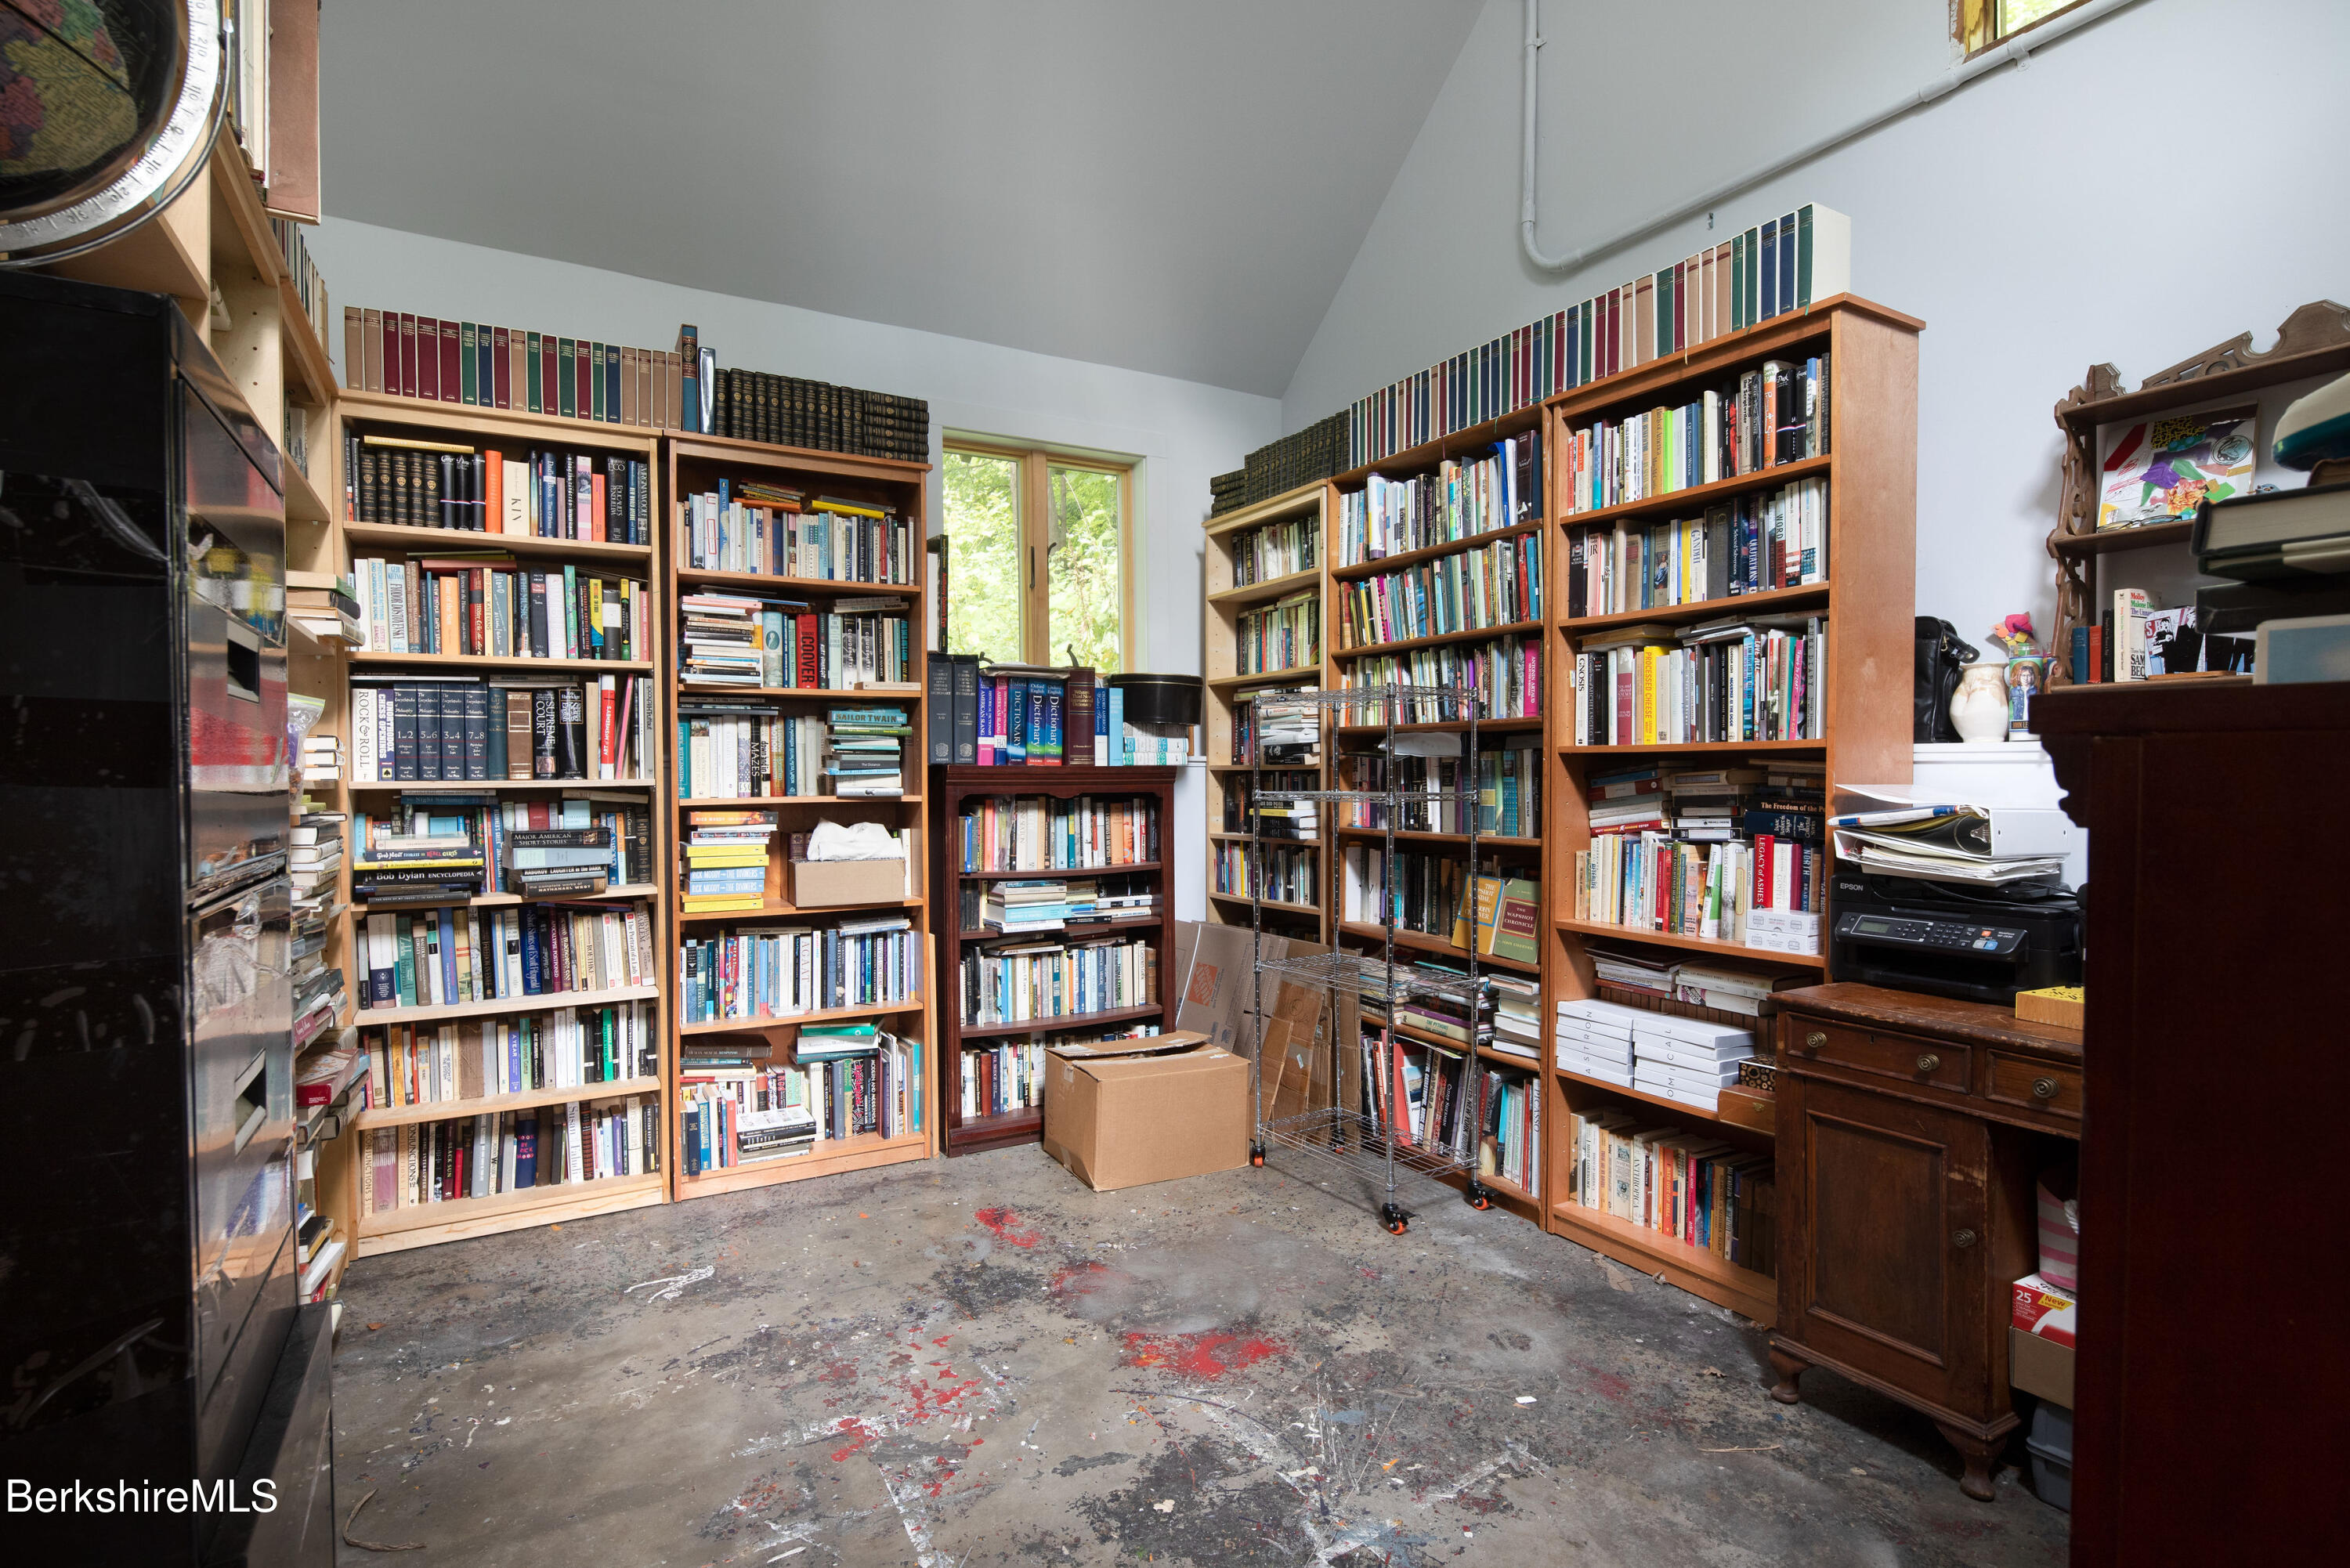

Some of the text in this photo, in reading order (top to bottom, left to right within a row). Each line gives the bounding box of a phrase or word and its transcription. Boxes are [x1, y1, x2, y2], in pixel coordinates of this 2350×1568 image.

[1775, 514, 1784, 540] WORD
[1690, 529, 1701, 565] GANDHI
[1748, 539, 1759, 582] QUOTATIONS
[390, 583, 405, 639] FYODOR DOSTOYEVSKY
[2131, 592, 2146, 602] Molloy
[801, 637, 815, 683] COOVER
[1578, 658, 1586, 692] GNOSIS
[359, 692, 369, 724] ROCK
[537, 701, 545, 735] COURT
[546, 701, 555, 744] SUPREME
[1013, 690, 1022, 747] DICTIONARY
[1030, 695, 1043, 747] Dictionary
[1047, 695, 1059, 747] Dictionary
[360, 739, 370, 768] ROLL
[1757, 836, 1766, 869] LEGACY
[398, 872, 425, 880] Dylan
[1840, 883, 1864, 891] EPSON
[1503, 918, 1535, 929] CHRONICLE
[1506, 911, 1535, 921] WAPSHOT
[400, 936, 411, 956] Zelda
[801, 941, 810, 982] AGAAT
[568, 1106, 580, 1175] Susan Faludi
[2016, 1289, 2032, 1304] 25
[2044, 1295, 2066, 1306] New
